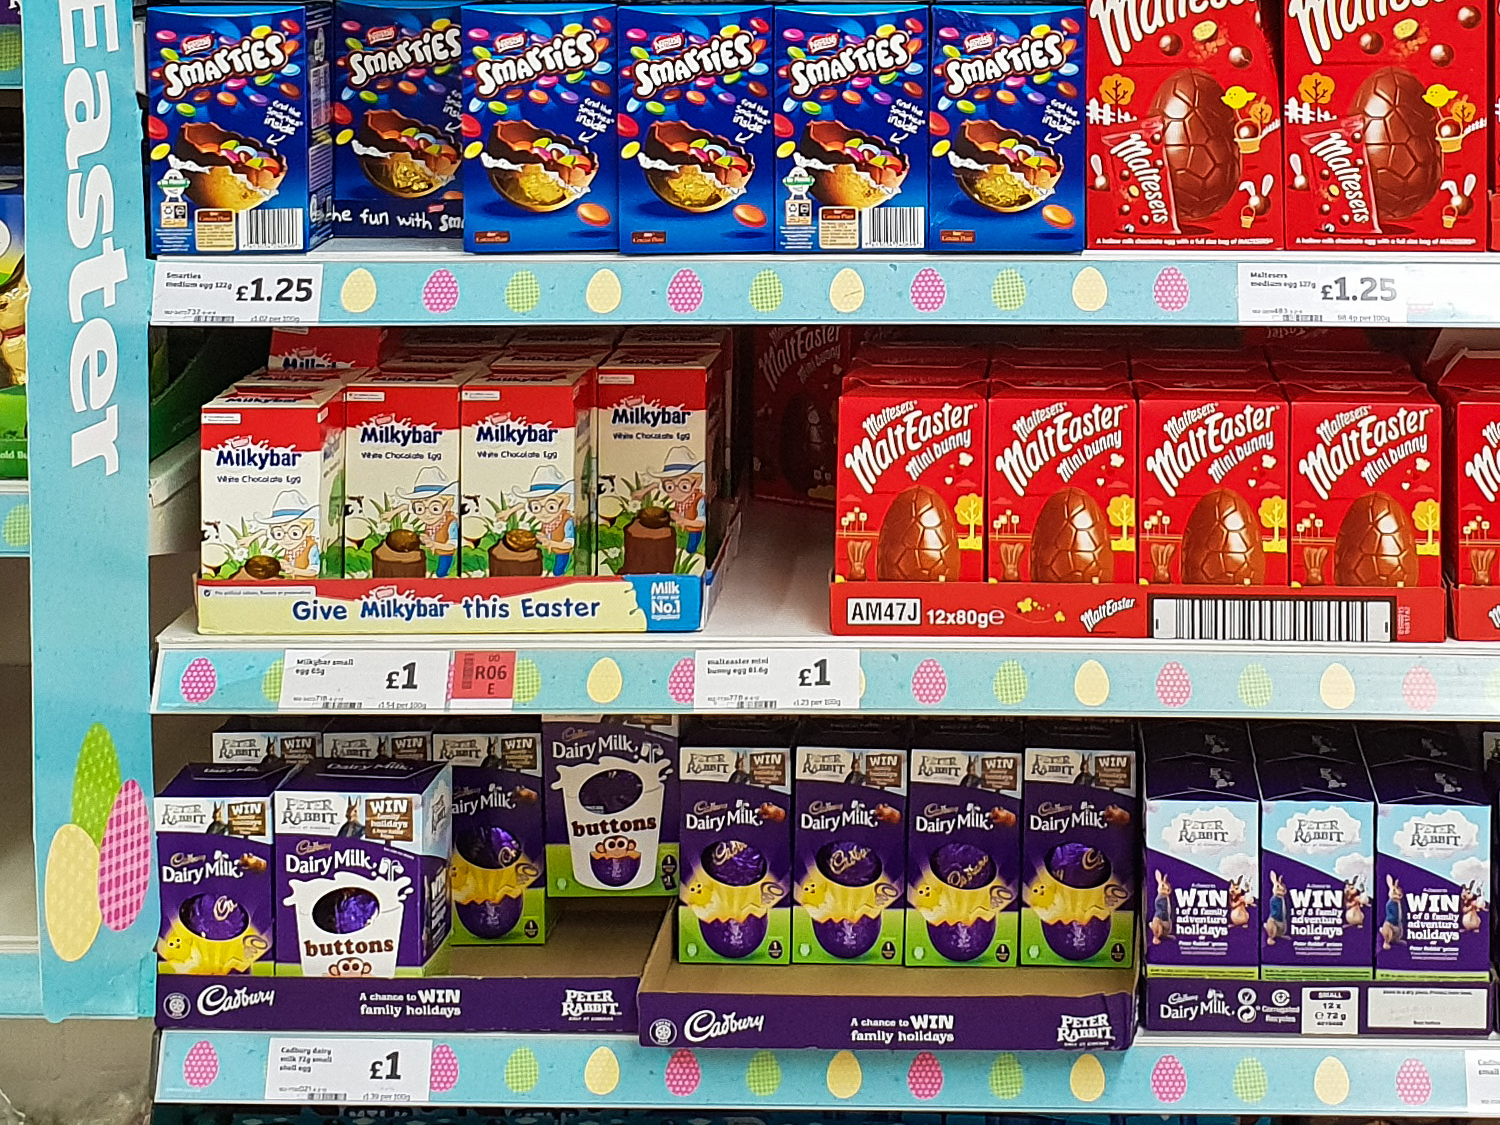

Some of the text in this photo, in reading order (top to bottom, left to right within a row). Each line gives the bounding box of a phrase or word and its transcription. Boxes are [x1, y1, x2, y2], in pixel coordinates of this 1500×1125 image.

[397, 212, 432, 229] with
[236, 278, 313, 302] £1.25
[1321, 277, 1397, 302] £1.25
[863, 401, 914, 438] Maltesers
[845, 404, 972, 493] MaltEaster
[934, 430, 972, 467] bunny
[216, 449, 301, 470] Milkybar
[651, 581, 680, 594] Milk
[292, 598, 601, 621] Give Milkybar this Easter
[651, 602, 681, 614] No.1
[851, 602, 918, 622] AM47J
[386, 663, 418, 689] £1
[475, 666, 508, 681] R06
[798, 659, 830, 687] £1
[488, 683, 495, 695] E
[686, 808, 759, 832] Dairy Milk
[1289, 889, 1343, 908] WIN
[1290, 925, 1343, 938] holidays
[304, 936, 394, 957] buttons
[197, 985, 276, 1016] Cadbury
[369, 992, 404, 1002] chance
[418, 989, 461, 1004] WIN
[359, 1003, 461, 1018] family holidays
[370, 1051, 401, 1080] £1
